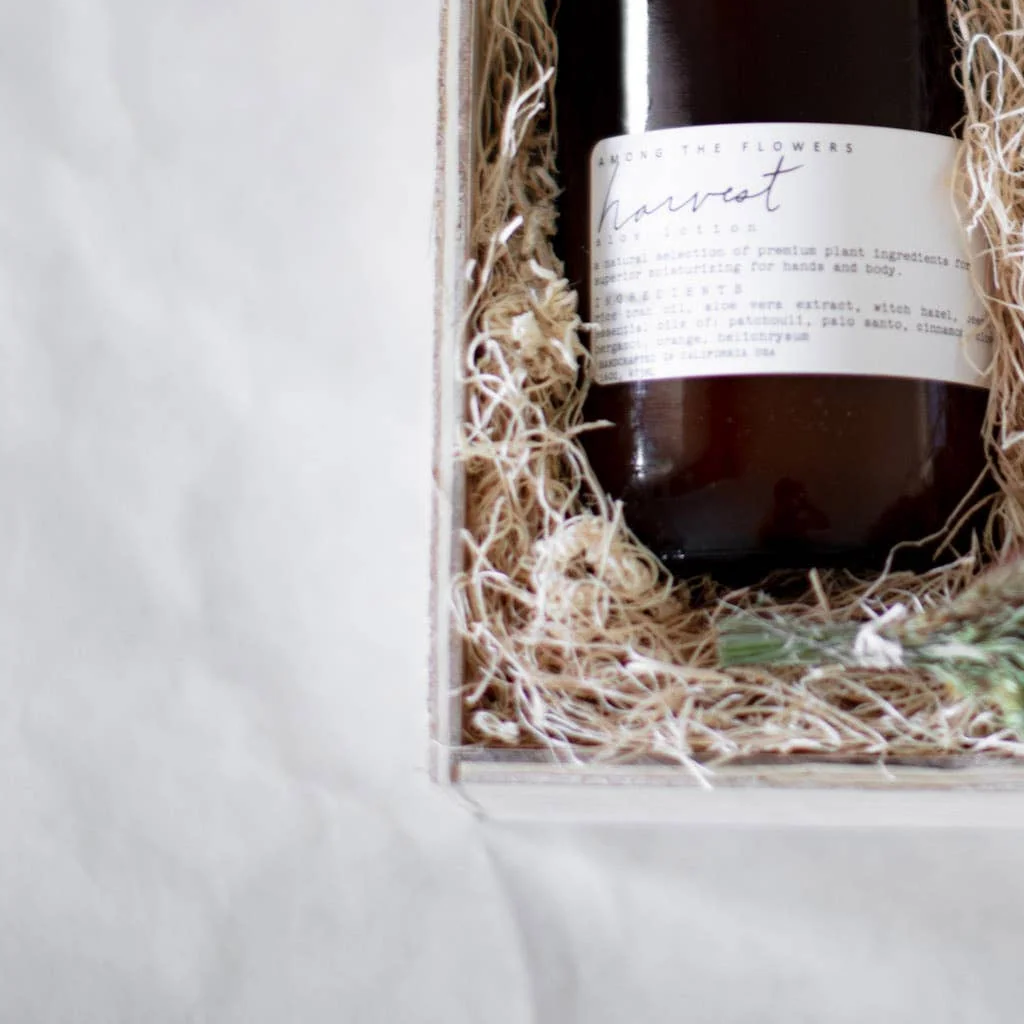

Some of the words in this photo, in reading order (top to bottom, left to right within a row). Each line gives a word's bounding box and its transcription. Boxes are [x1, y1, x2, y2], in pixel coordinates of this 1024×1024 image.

[598, 148, 663, 166] AMONG
[682, 143, 721, 156] THE
[742, 141, 853, 154] FLOWERS
[597, 155, 804, 233] harvest
[664, 224, 757, 238] lotion
[604, 254, 648, 269] natural
[656, 247, 726, 261] selection
[732, 245, 749, 257] of
[758, 244, 817, 258] premium
[825, 245, 865, 258] plant
[874, 247, 949, 267] ingredients
[594, 271, 643, 286] superior
[648, 261, 742, 278] moisturizing
[751, 260, 776, 272] for
[782, 261, 825, 273] hands
[833, 262, 857, 274] and
[866, 262, 903, 277] body.
[656, 319, 687, 331] oils
[729, 314, 812, 330] patchouli,
[822, 314, 855, 329] palo
[864, 316, 909, 332] santo,
[705, 300, 738, 313] aloe
[750, 300, 783, 311] vera
[797, 298, 861, 314] extract,
[874, 301, 911, 315] witch
[920, 305, 958, 323] hazel,
[755, 346, 777, 357] USA
